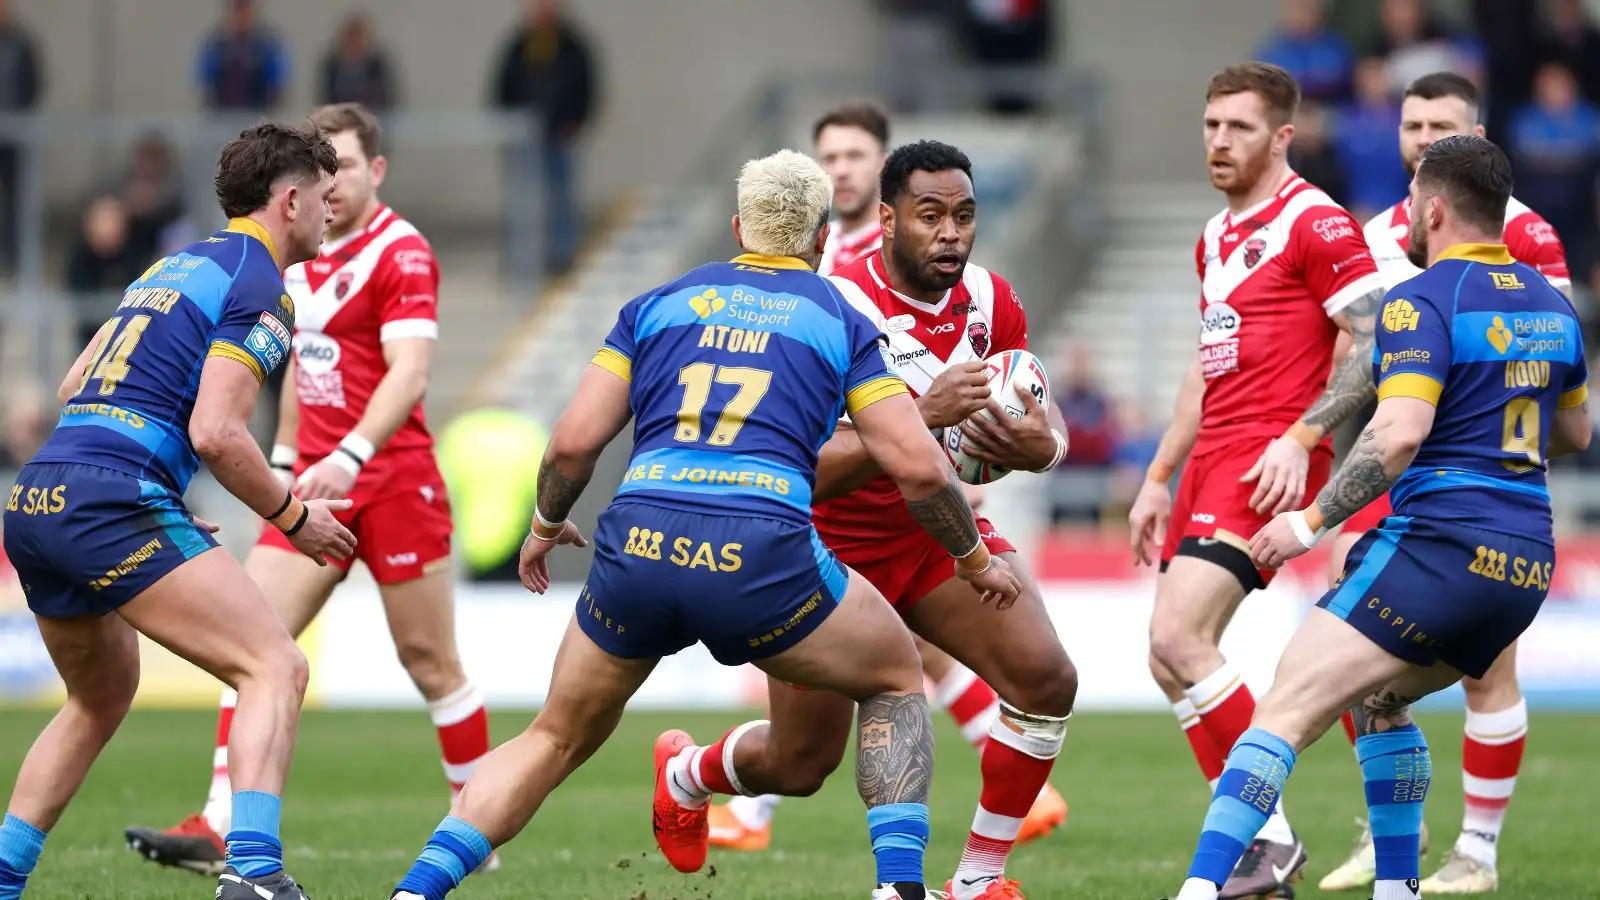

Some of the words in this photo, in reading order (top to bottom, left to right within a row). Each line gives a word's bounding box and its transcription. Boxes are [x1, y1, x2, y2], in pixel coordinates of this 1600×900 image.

[728, 303, 792, 327] Support
[731, 289, 755, 306] Be
[760, 295, 799, 313] Well
[698, 324, 771, 354] ATONI
[1392, 347, 1431, 361] amico
[72, 314, 152, 397] 14
[897, 347, 930, 363] morson
[1505, 360, 1550, 389] HOOD
[673, 362, 773, 446] 17
[1502, 397, 1541, 474] 9
[671, 467, 790, 495] JOINERS
[22, 484, 67, 516] SAS
[669, 536, 743, 573] SAS
[1509, 556, 1552, 591] SAS
